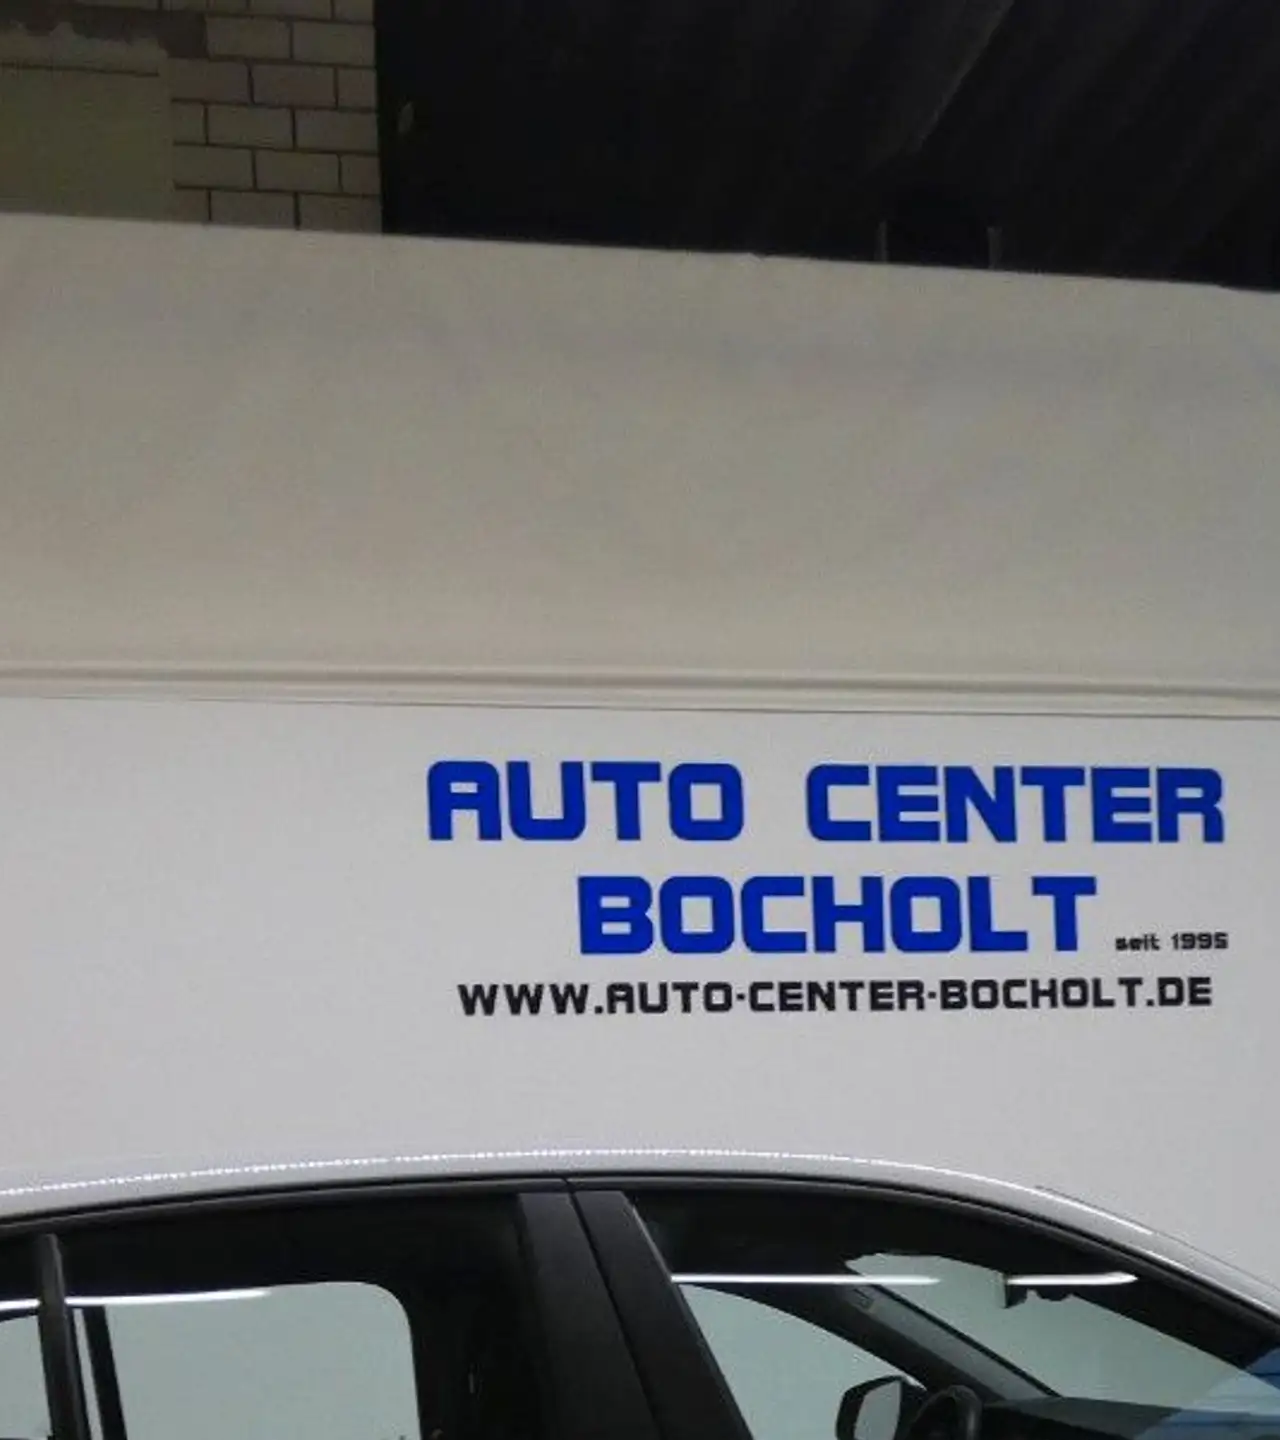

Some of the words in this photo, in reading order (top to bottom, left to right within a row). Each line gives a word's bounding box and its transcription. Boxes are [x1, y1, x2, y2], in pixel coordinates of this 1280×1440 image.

[427, 760, 746, 843] AUTO
[806, 763, 1225, 844] CENTER
[577, 875, 1098, 956] BOCHOLT
[1114, 932, 1161, 952] seit
[1170, 930, 1229, 951] 1995
[457, 976, 1213, 1017] WWW.AUTO-CENTER-BOCHOLT.DE
